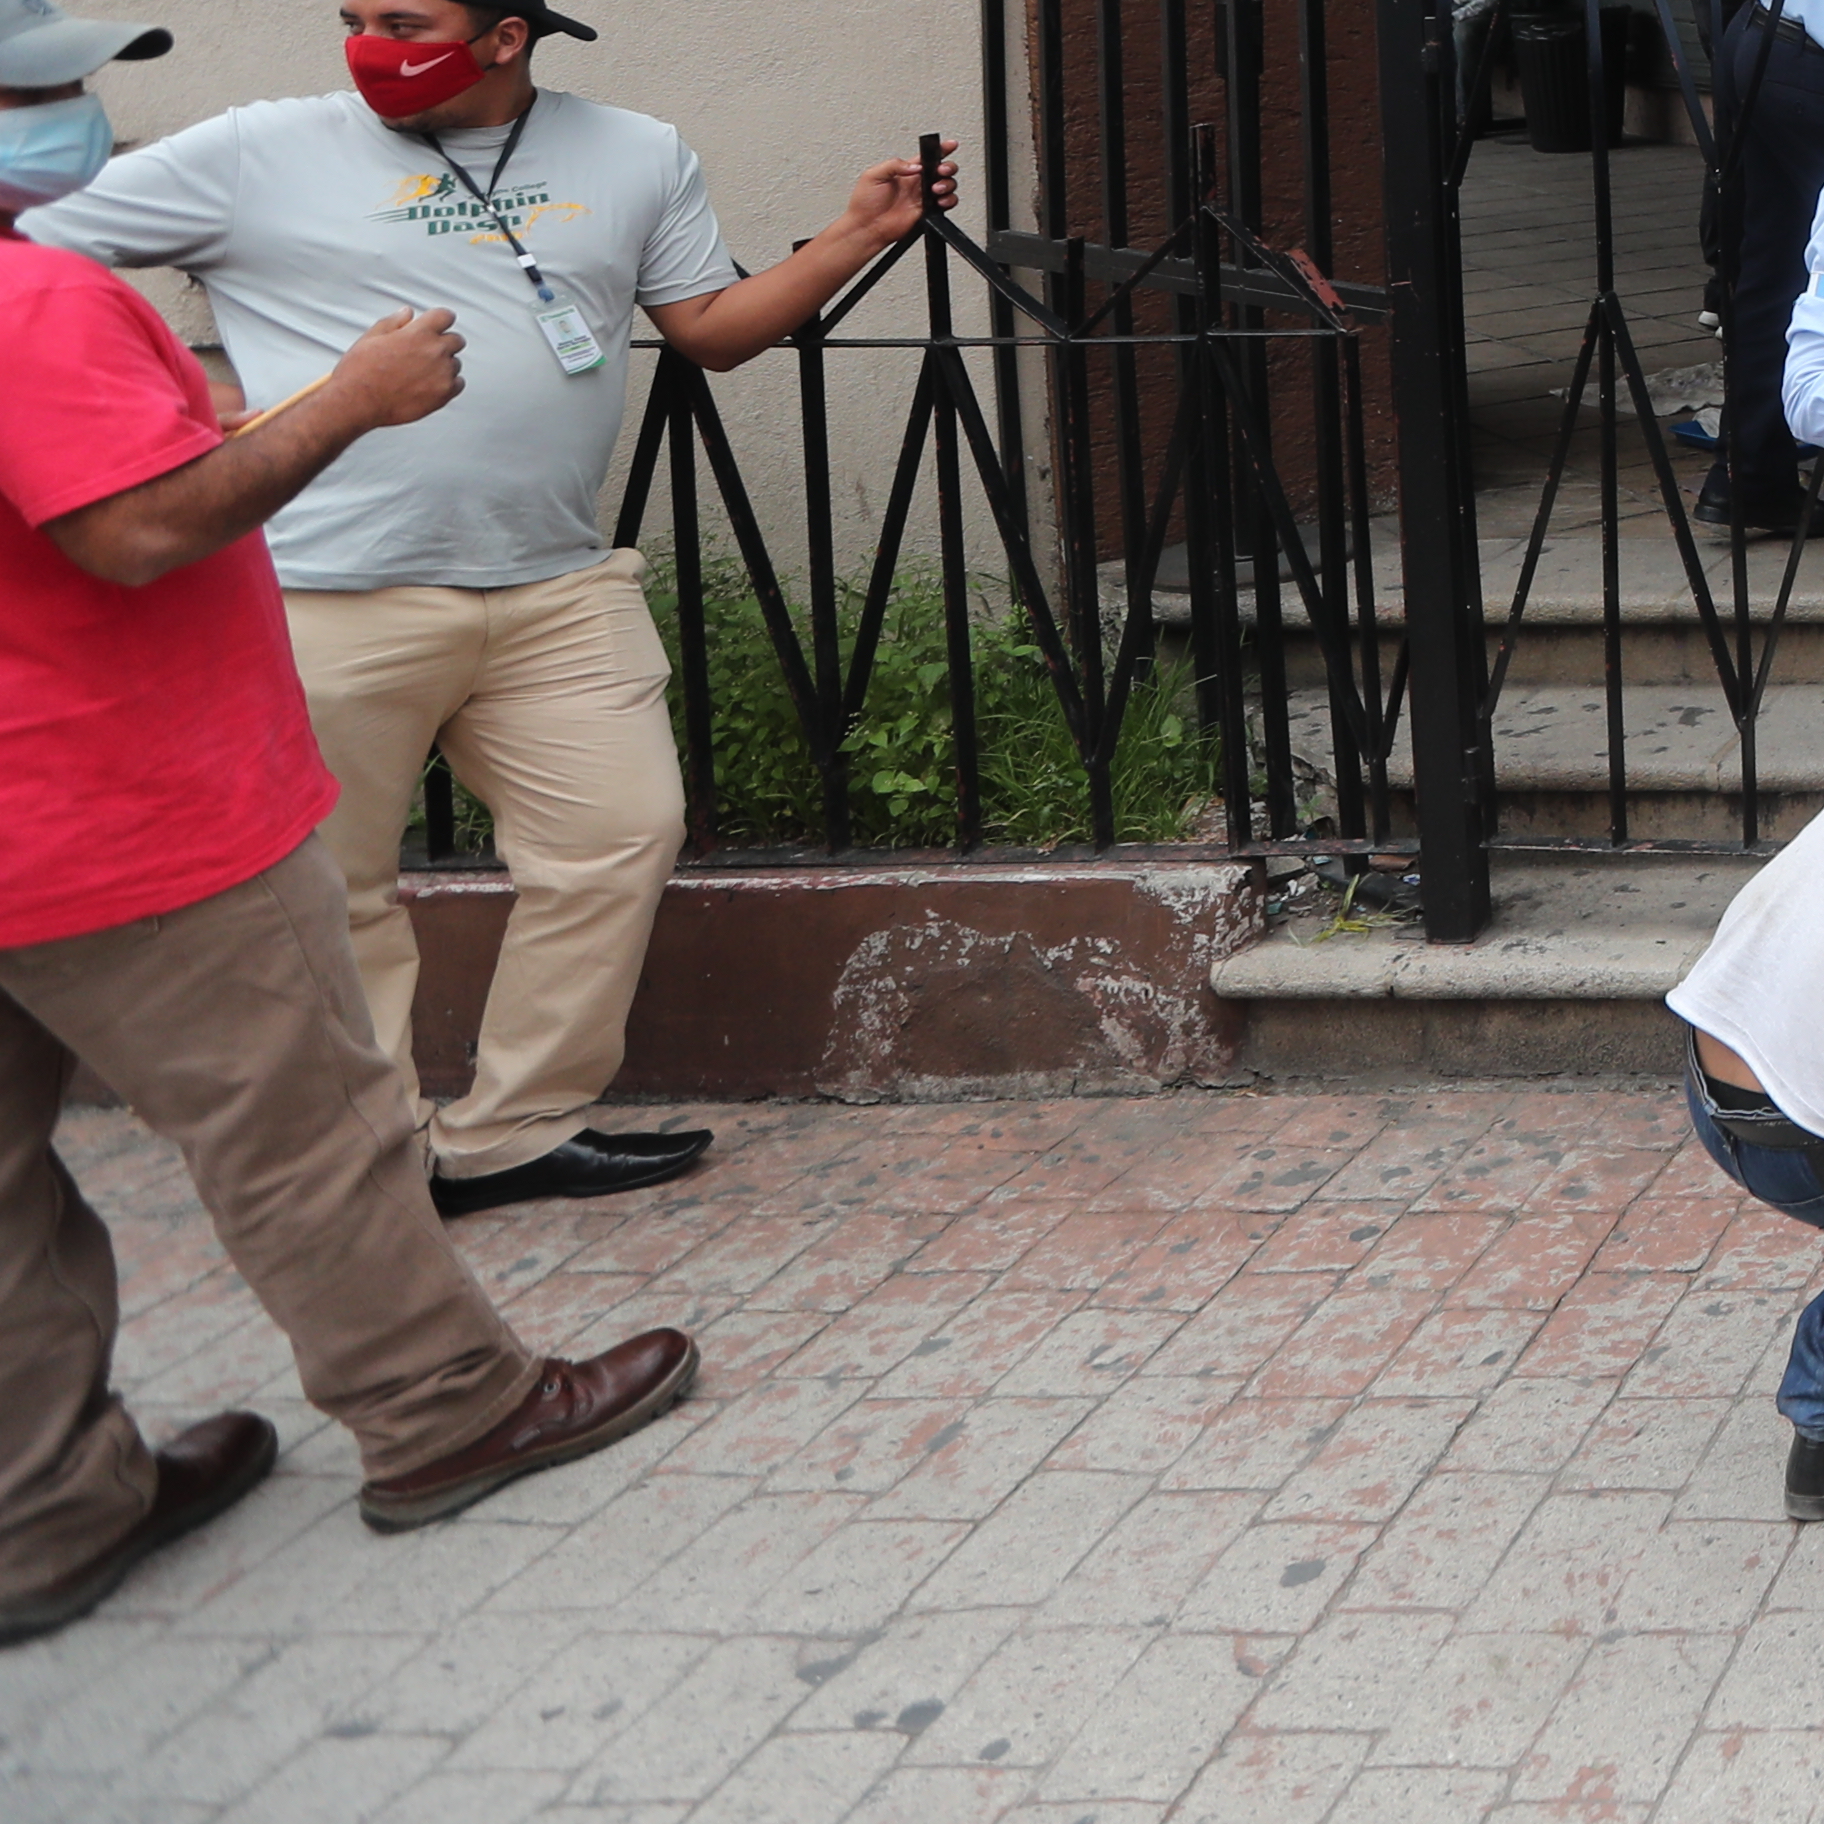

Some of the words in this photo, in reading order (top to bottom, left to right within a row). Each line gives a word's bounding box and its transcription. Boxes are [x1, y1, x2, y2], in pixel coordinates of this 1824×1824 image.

[511, 181, 548, 193] College
[408, 192, 550, 220] Dolphin
[427, 214, 523, 236] Dash
